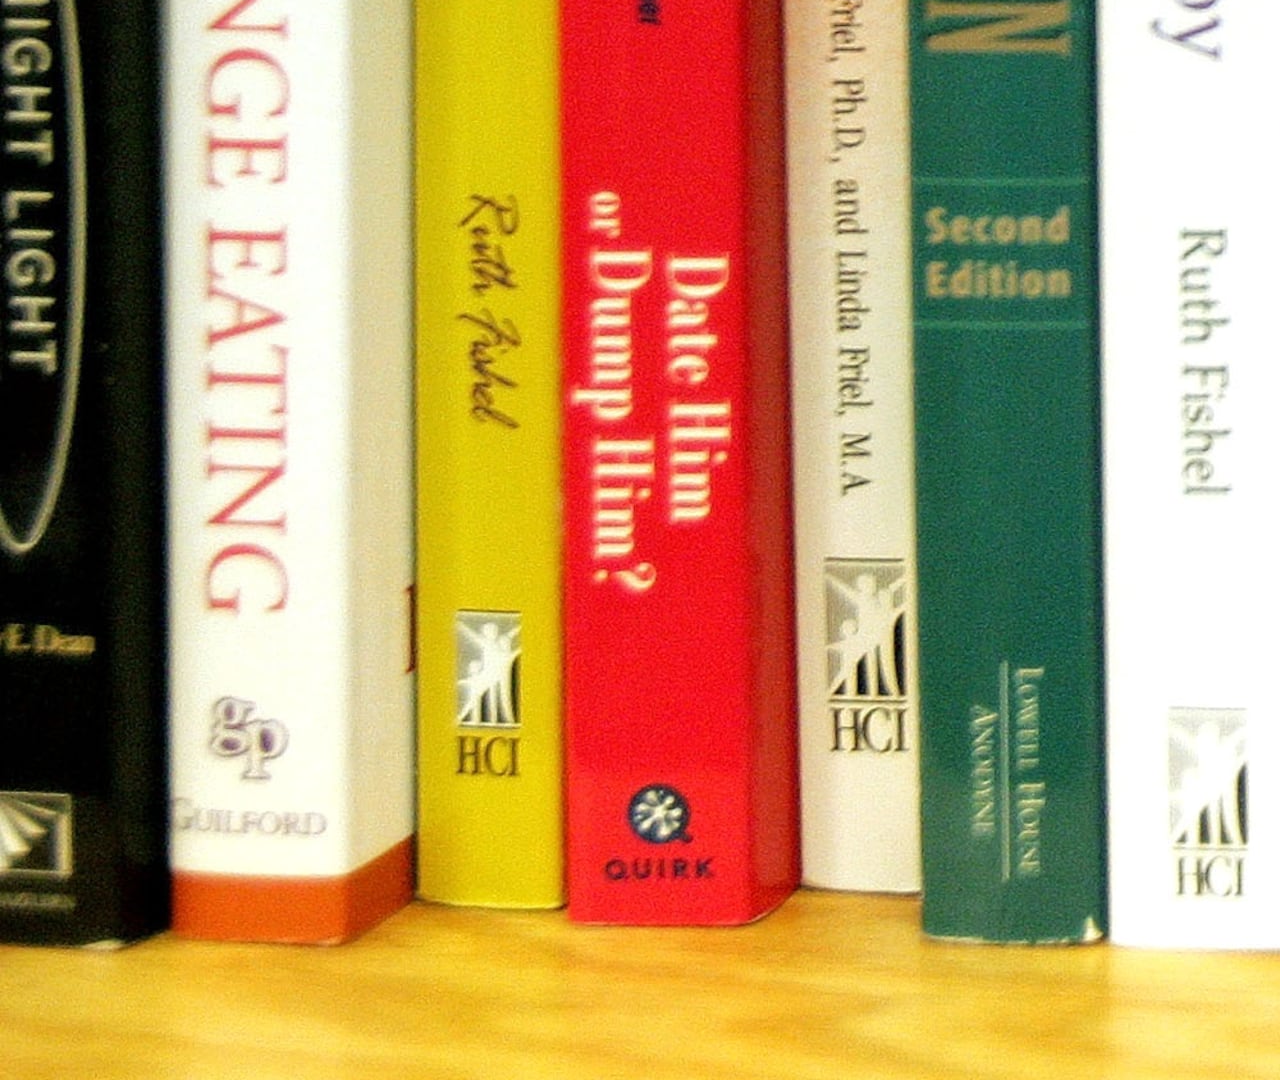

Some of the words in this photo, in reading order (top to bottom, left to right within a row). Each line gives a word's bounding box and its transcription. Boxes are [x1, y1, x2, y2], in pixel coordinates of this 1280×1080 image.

[4, 191, 56, 374] LIGHT
[927, 206, 1071, 245] Second
[927, 262, 1072, 299] Edition
[572, 250, 652, 421] Dump
[667, 255, 729, 382] Date
[1179, 227, 1229, 347] Ruth
[205, 229, 289, 615] EATING
[669, 404, 732, 524] Him
[1182, 361, 1233, 498] Fishel
[592, 438, 657, 592] Him?
[455, 737, 520, 776] HCI
[172, 797, 328, 837] GUILFORD
[605, 857, 714, 881] QUIRK
[1174, 858, 1247, 898] HCI
